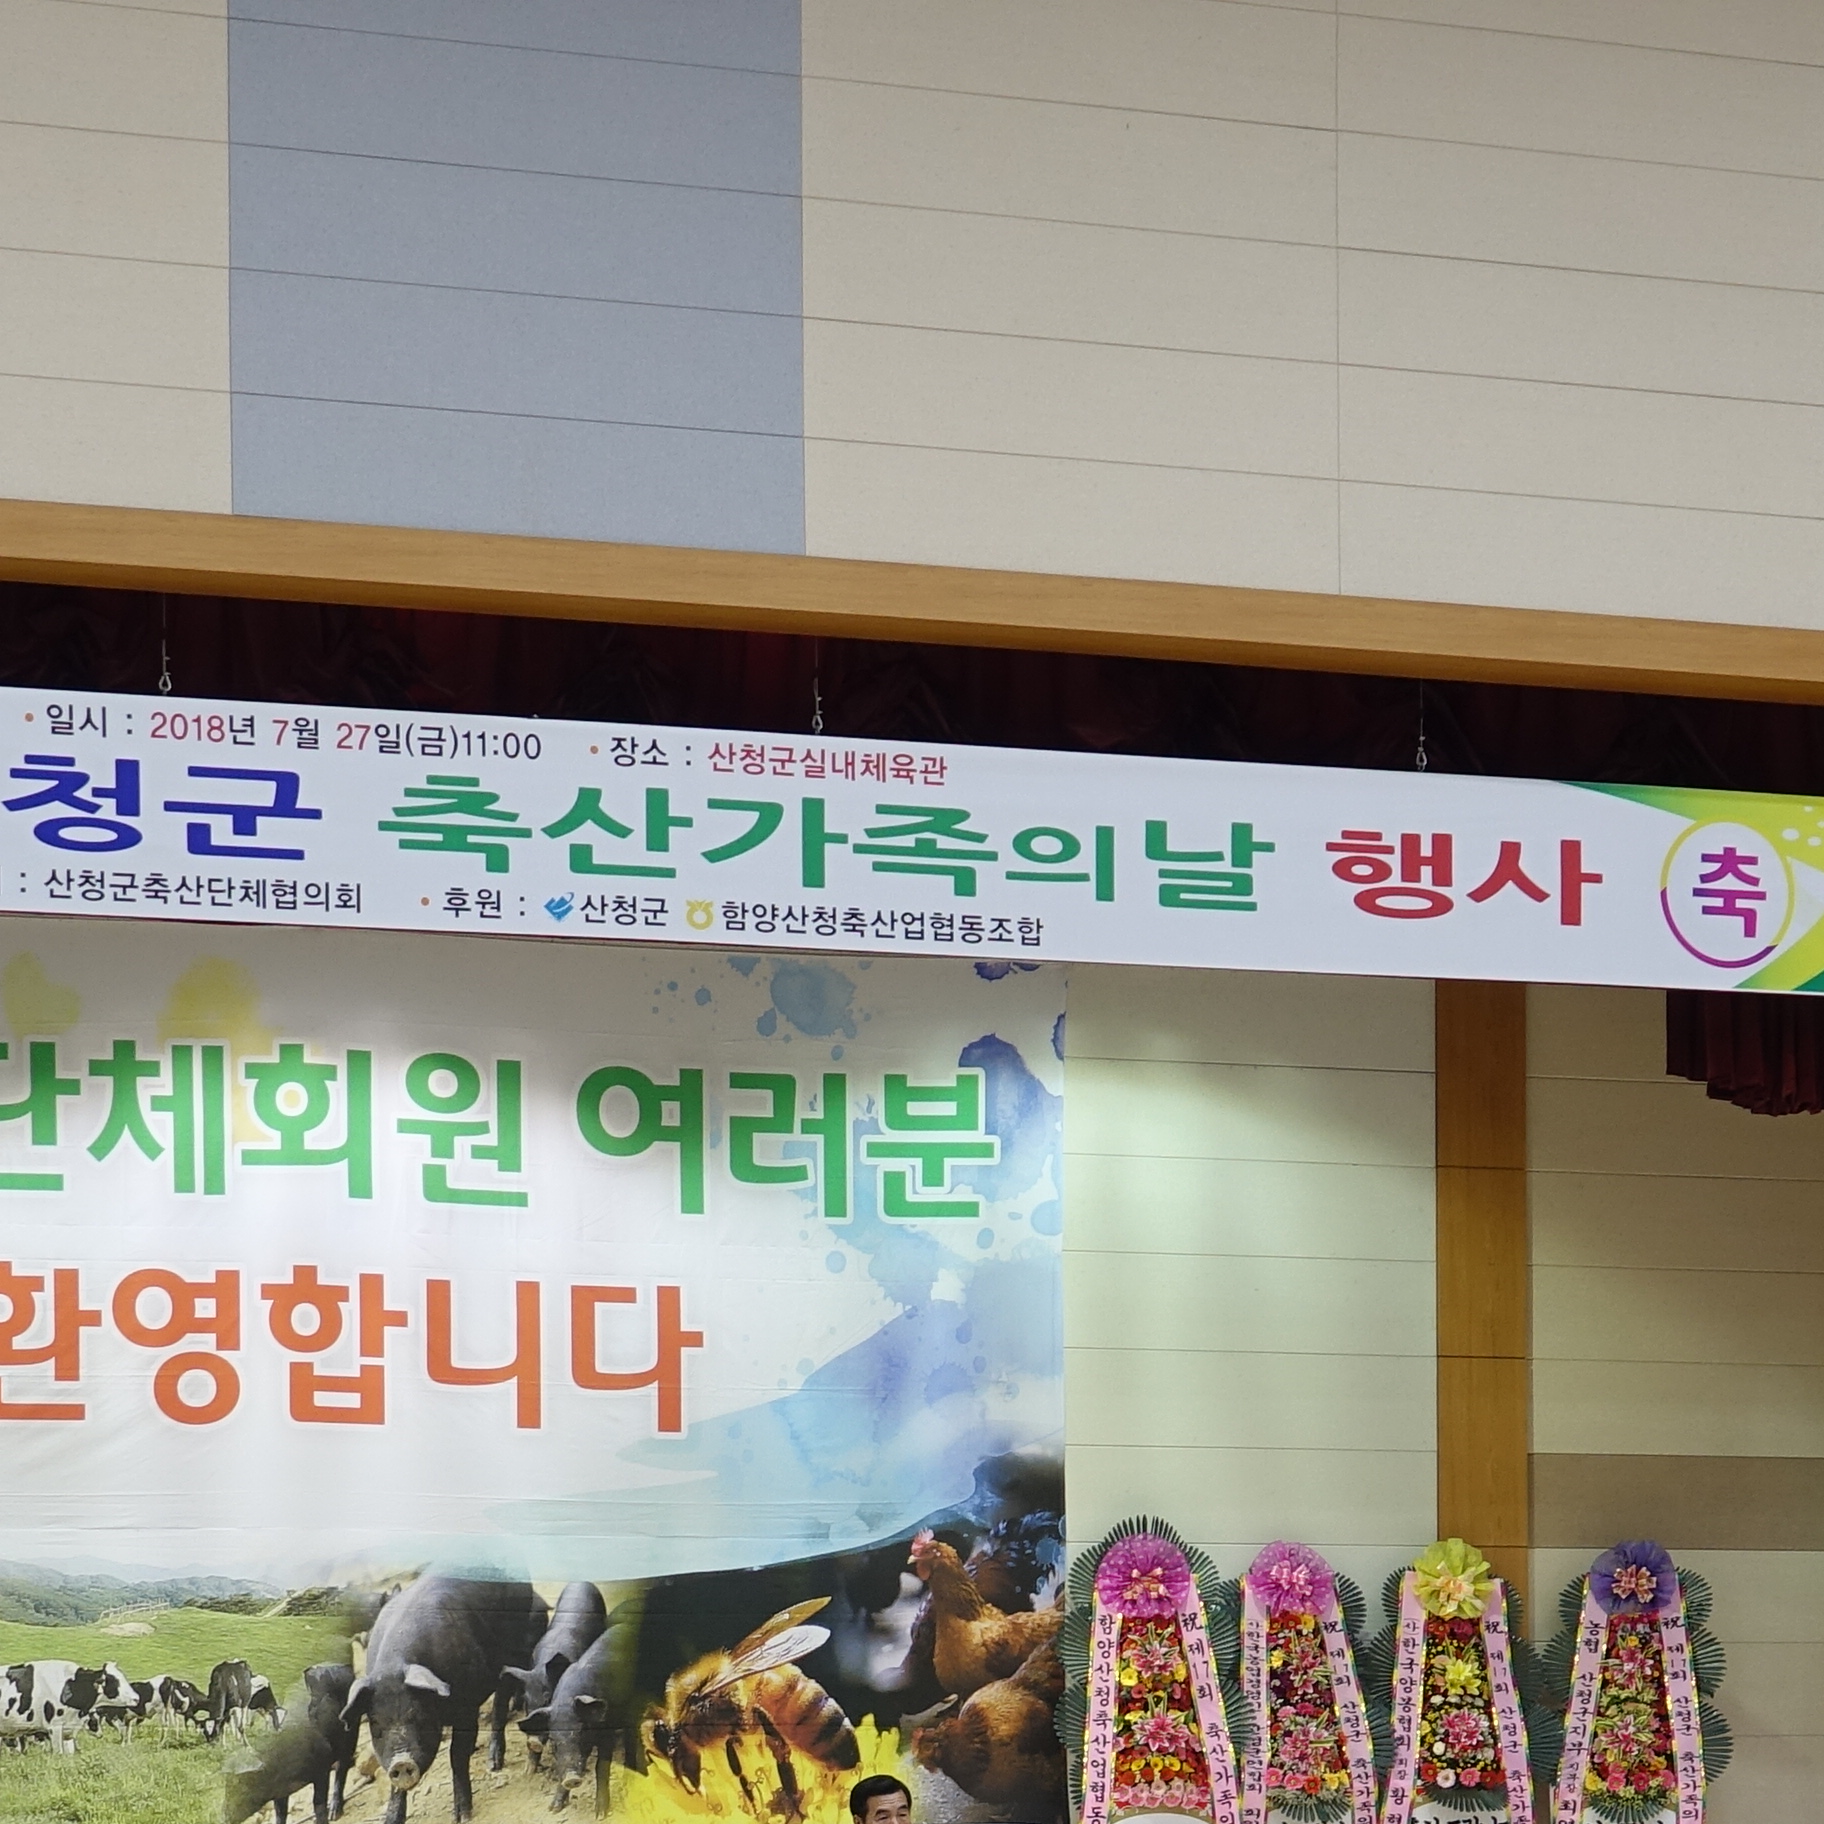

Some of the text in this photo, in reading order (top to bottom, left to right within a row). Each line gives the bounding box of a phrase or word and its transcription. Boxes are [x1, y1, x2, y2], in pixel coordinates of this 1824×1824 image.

[46, 704, 541, 761] 일시 2018년 7월 27일(금)11:00
[609, 737, 948, 786] 장소 산청군실내체육관
[44, 867, 362, 913] 산청군축산단체협의회
[1325, 829, 1604, 926] 행사
[1692, 846, 1767, 938] 축
[443, 889, 1044, 946] 후원 산청군 함양산청축산업협동조합
[577, 1065, 996, 1218] 여러분
[1583, 1618, 1607, 1654] 농협
[1188, 1641, 1215, 1701] 제17회
[1340, 1701, 1367, 1743] 산청군
[1498, 1706, 1524, 1754] 산청군
[1566, 1671, 1597, 1755] 산청군지부
[1674, 1696, 1698, 1737] 산청군
